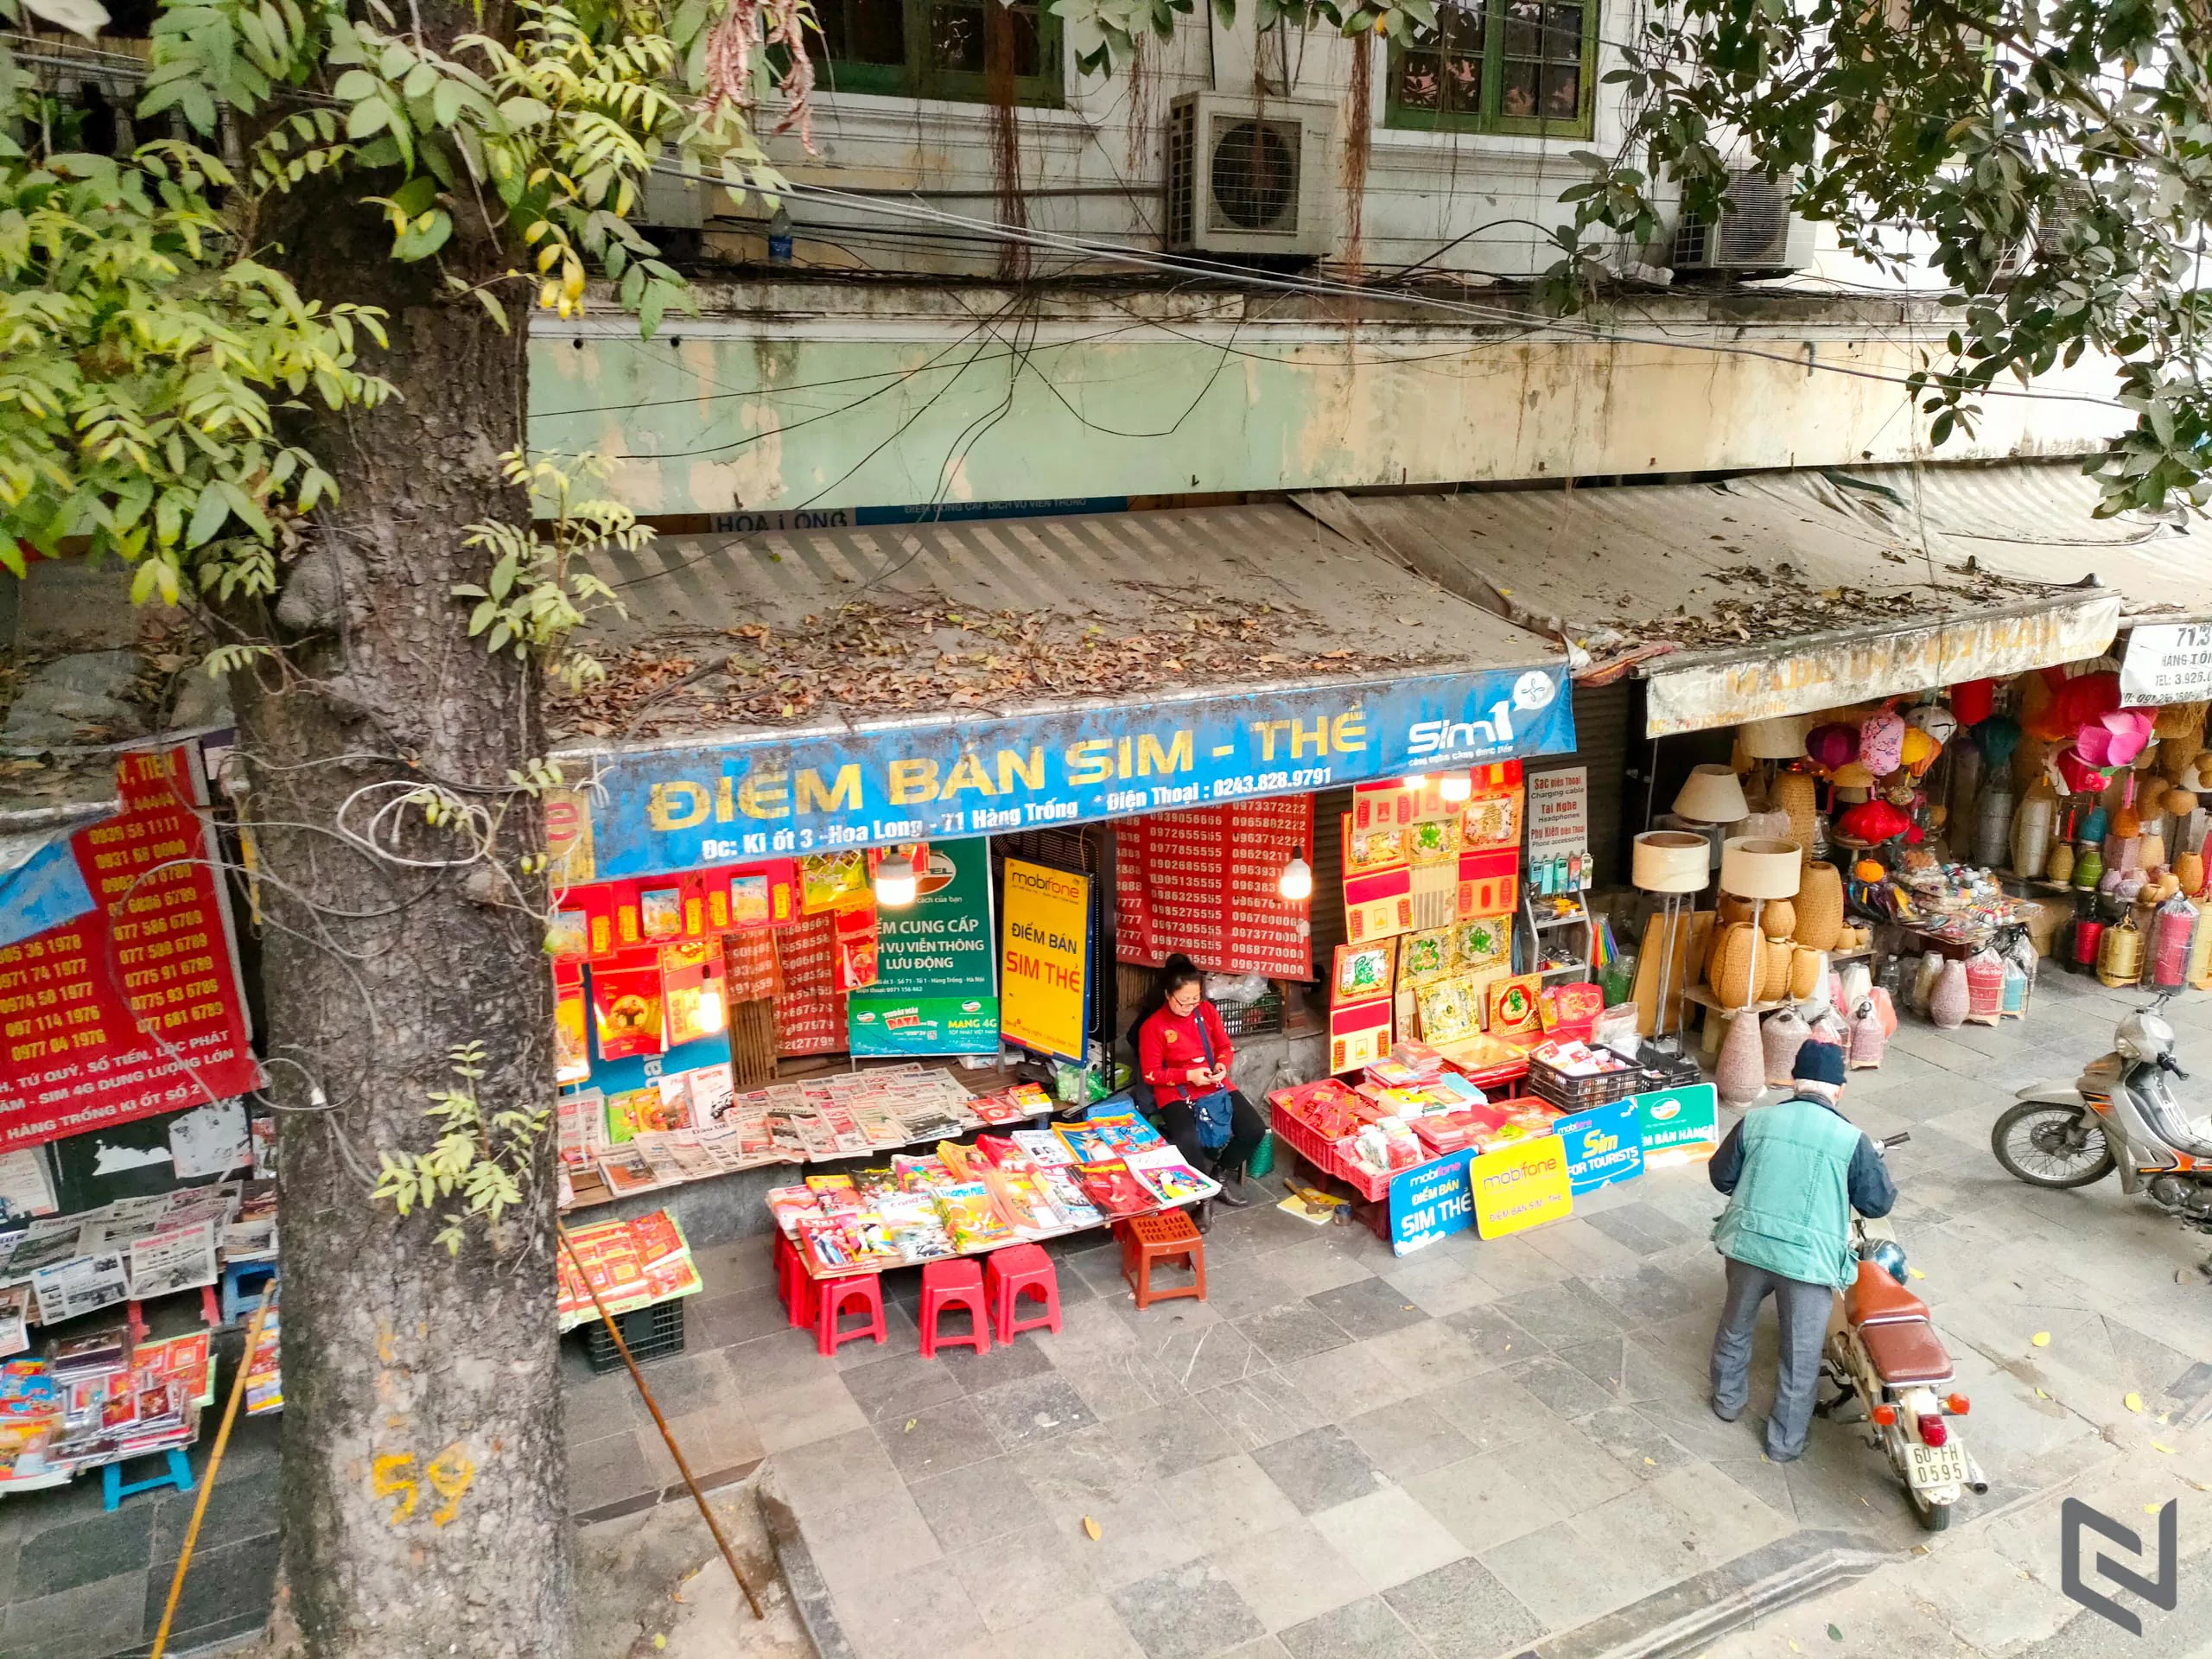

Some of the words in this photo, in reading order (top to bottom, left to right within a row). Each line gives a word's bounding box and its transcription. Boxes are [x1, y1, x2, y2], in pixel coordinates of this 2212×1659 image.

[889, 741, 1045, 805] BÁN
[1065, 729, 1194, 786] SIM
[1250, 701, 1367, 761] THẺ
[1106, 788, 1147, 812] Điện
[1150, 781, 1198, 804] Thoại
[1213, 767, 1332, 797] 0243.828.9791
[1531, 790, 1564, 799] Charging
[799, 829, 813, 848] 3
[874, 819, 923, 839] Long
[973, 805, 1020, 830] Hàng
[1025, 797, 1078, 821] Trống
[1538, 813, 1580, 823] Headphones
[1551, 835, 1586, 845] accessories
[1012, 872, 1079, 898] mobifone
[899, 919, 945, 934] CUNG
[947, 915, 979, 932] CẤP
[885, 942, 905, 956] VỤ
[906, 938, 936, 953] VIỄN
[938, 938, 985, 951] THÔNG
[1012, 922, 1045, 945] ĐIỂM
[1049, 933, 1077, 954] BÁN
[886, 957, 912, 969] LƯU
[914, 956, 954, 971] ĐỘNG
[1006, 950, 1039, 980] SIM
[1045, 963, 1080, 993] THẺ
[982, 1019, 997, 1028] 4G
[38, 1087, 70, 1104] SIM
[190, 1084, 200, 1095] 2
[1558, 1119, 1592, 1135] mobifone
[1655, 1129, 1678, 1146] BÁN
[1582, 1129, 1618, 1159] Sim
[1588, 1145, 1639, 1169] TOURISTS
[1410, 1161, 1461, 1187] mobifone
[1483, 1158, 1557, 1190] mobifone
[1438, 1179, 1459, 1196] BÁN
[1401, 1206, 1436, 1237] SIM
[1438, 1186, 1471, 1221] THẺ
[1913, 1442, 1959, 1465] 60-FH
[1917, 1462, 1962, 1483] 0595
